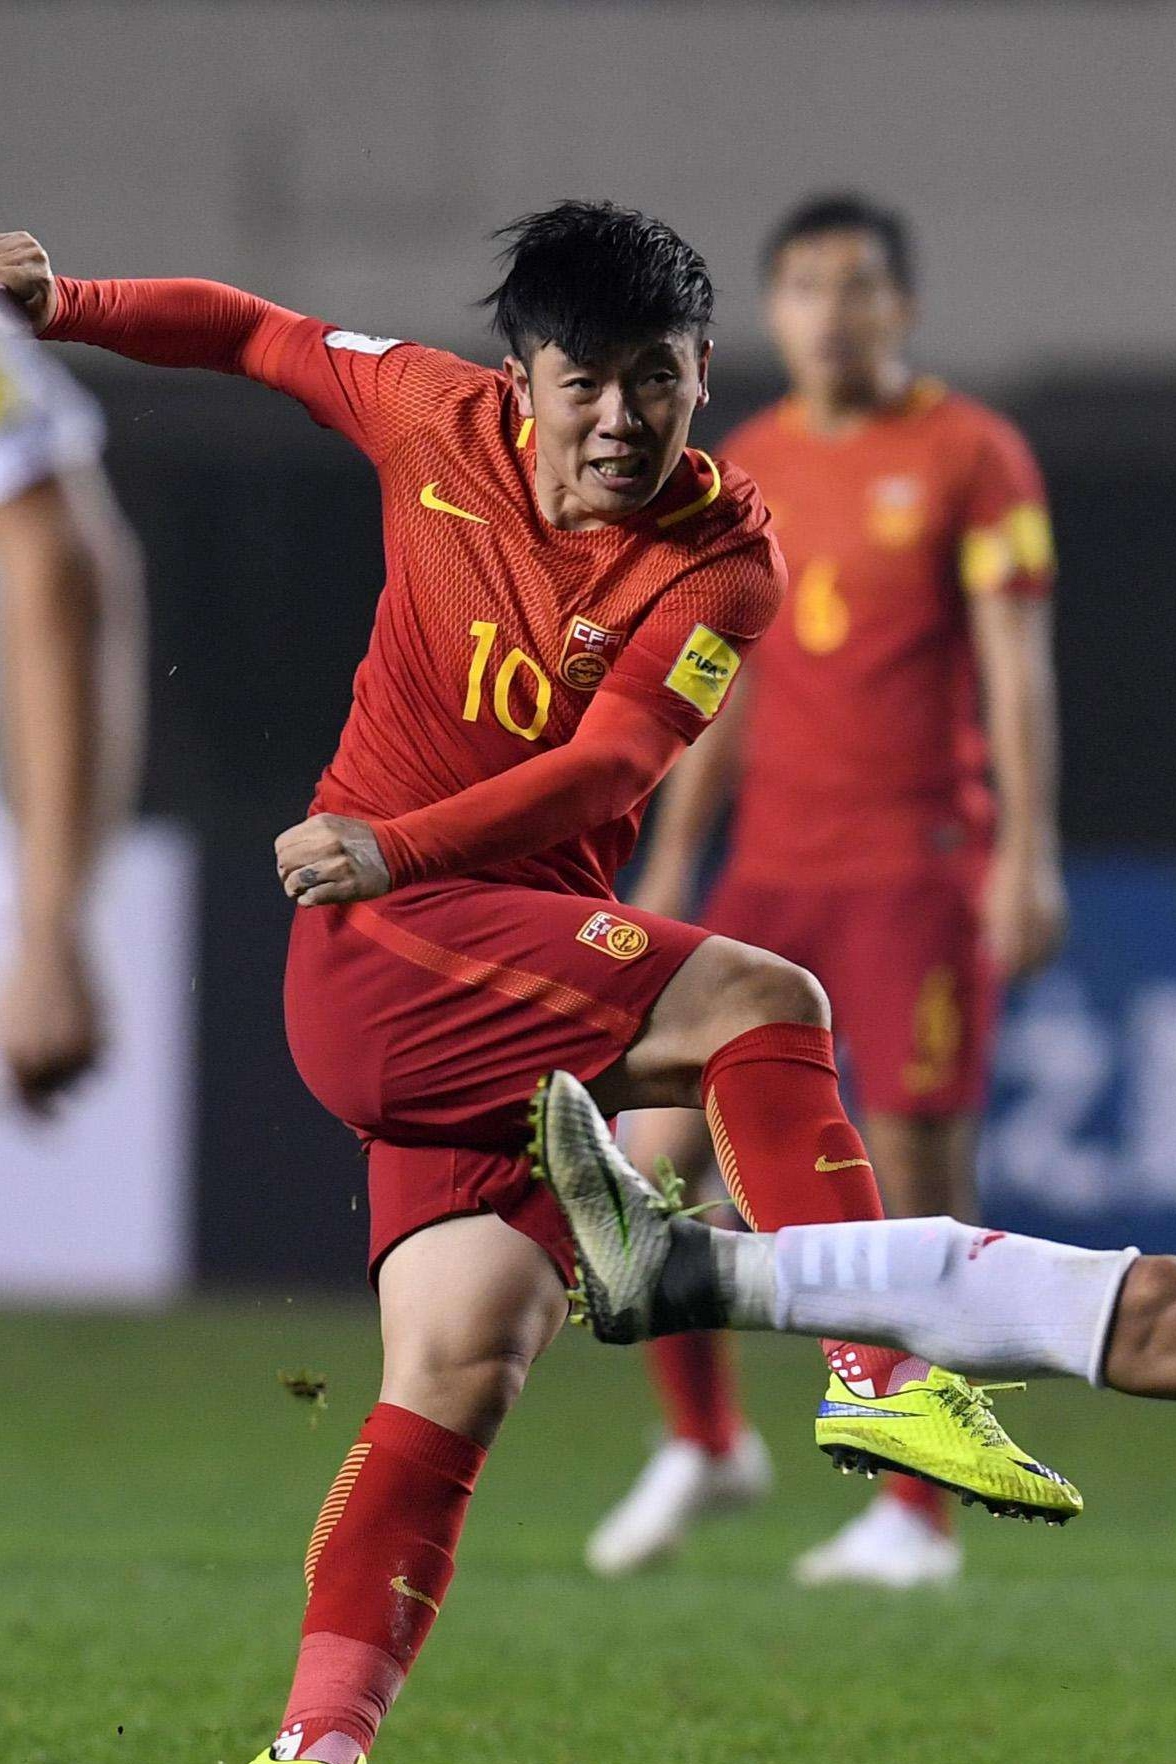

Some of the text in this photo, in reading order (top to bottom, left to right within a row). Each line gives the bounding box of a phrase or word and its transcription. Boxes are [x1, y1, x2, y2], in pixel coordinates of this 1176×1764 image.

[573, 623, 621, 646] CFA
[686, 650, 718, 676] FIFA
[462, 620, 551, 741] 10
